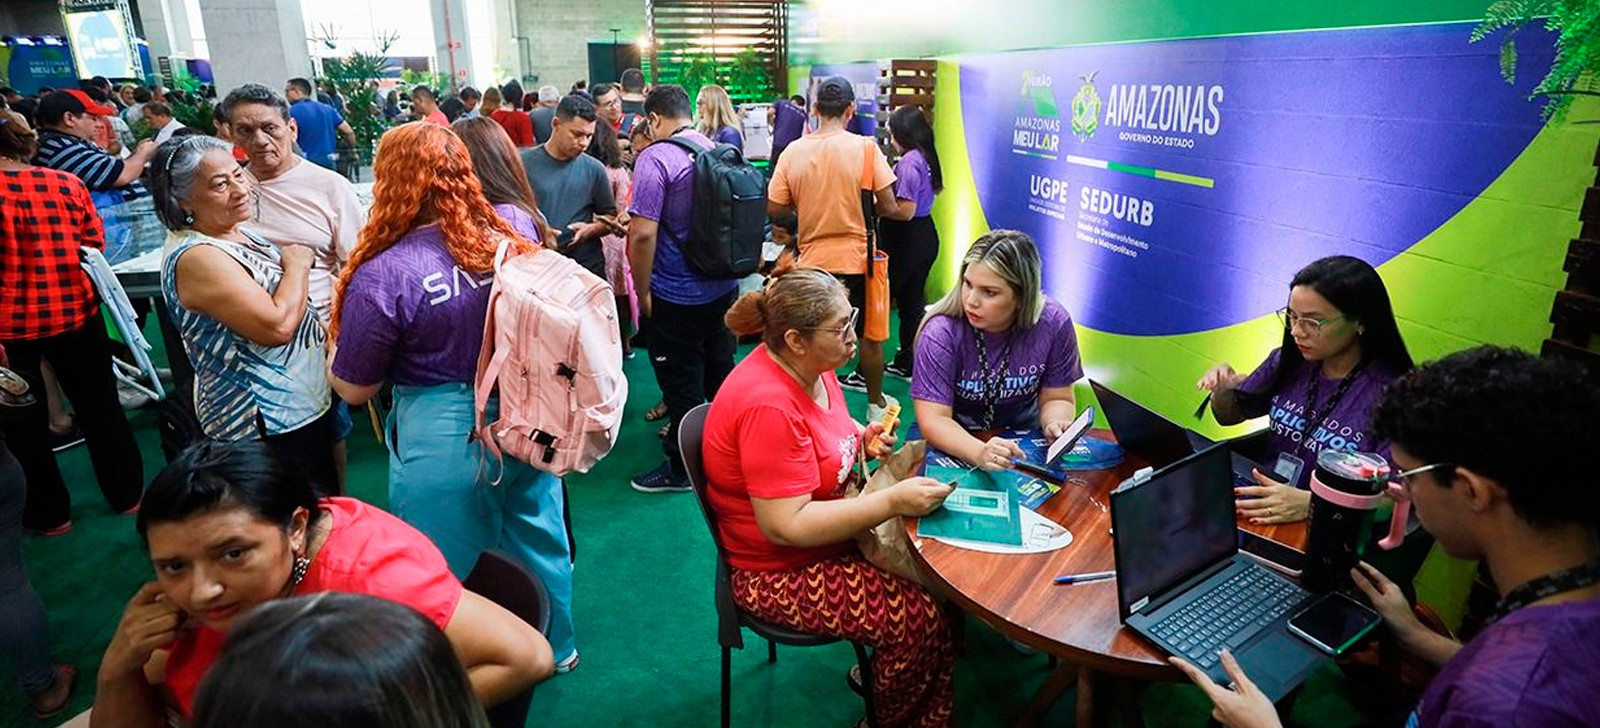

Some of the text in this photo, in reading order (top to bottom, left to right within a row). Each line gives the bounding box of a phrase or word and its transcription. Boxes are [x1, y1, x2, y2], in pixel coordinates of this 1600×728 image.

[1104, 84, 1224, 136] AMAZONAS
[1014, 116, 1060, 132] AMAZONAS
[1012, 129, 1060, 152] MEU LAR
[1118, 132, 1194, 149] GOVERNO DO ESTADO
[1030, 174, 1068, 204] UGPE
[1080, 186, 1154, 226] SEDURB
[422, 264, 493, 306] SA
[1018, 364, 1046, 376] DOS
[1328, 419, 1364, 443] DOS
